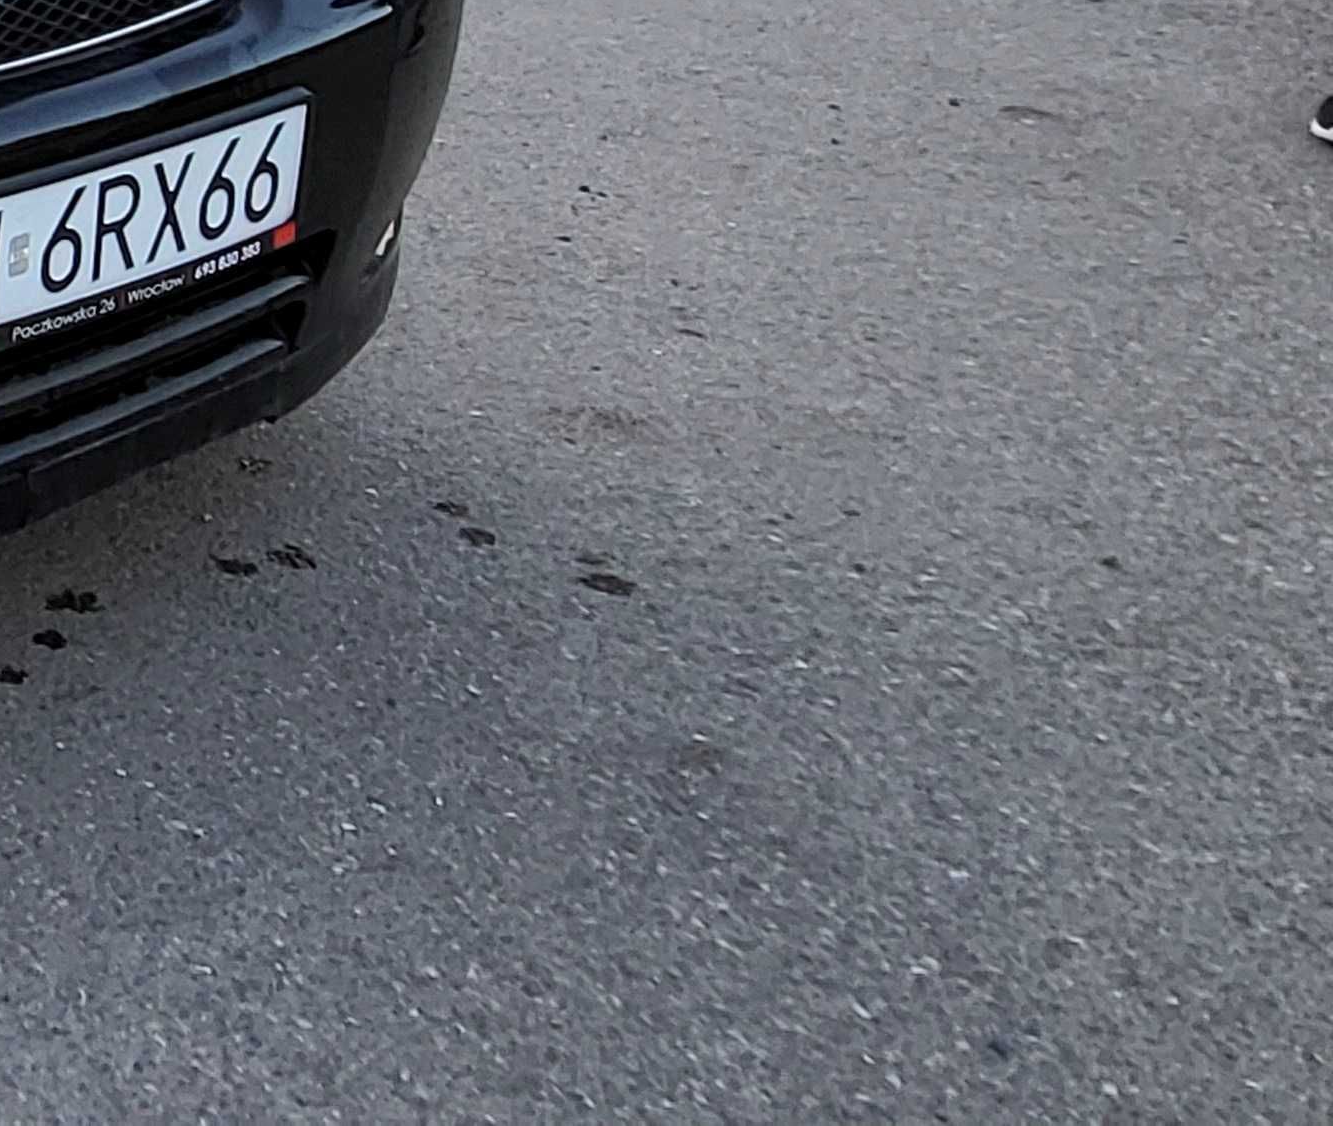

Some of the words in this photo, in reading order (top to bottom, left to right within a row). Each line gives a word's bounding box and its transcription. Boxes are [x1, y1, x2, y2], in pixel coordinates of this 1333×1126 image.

[41, 121, 286, 293] 6RX66
[99, 297, 116, 315] 26
[194, 262, 217, 281] 693
